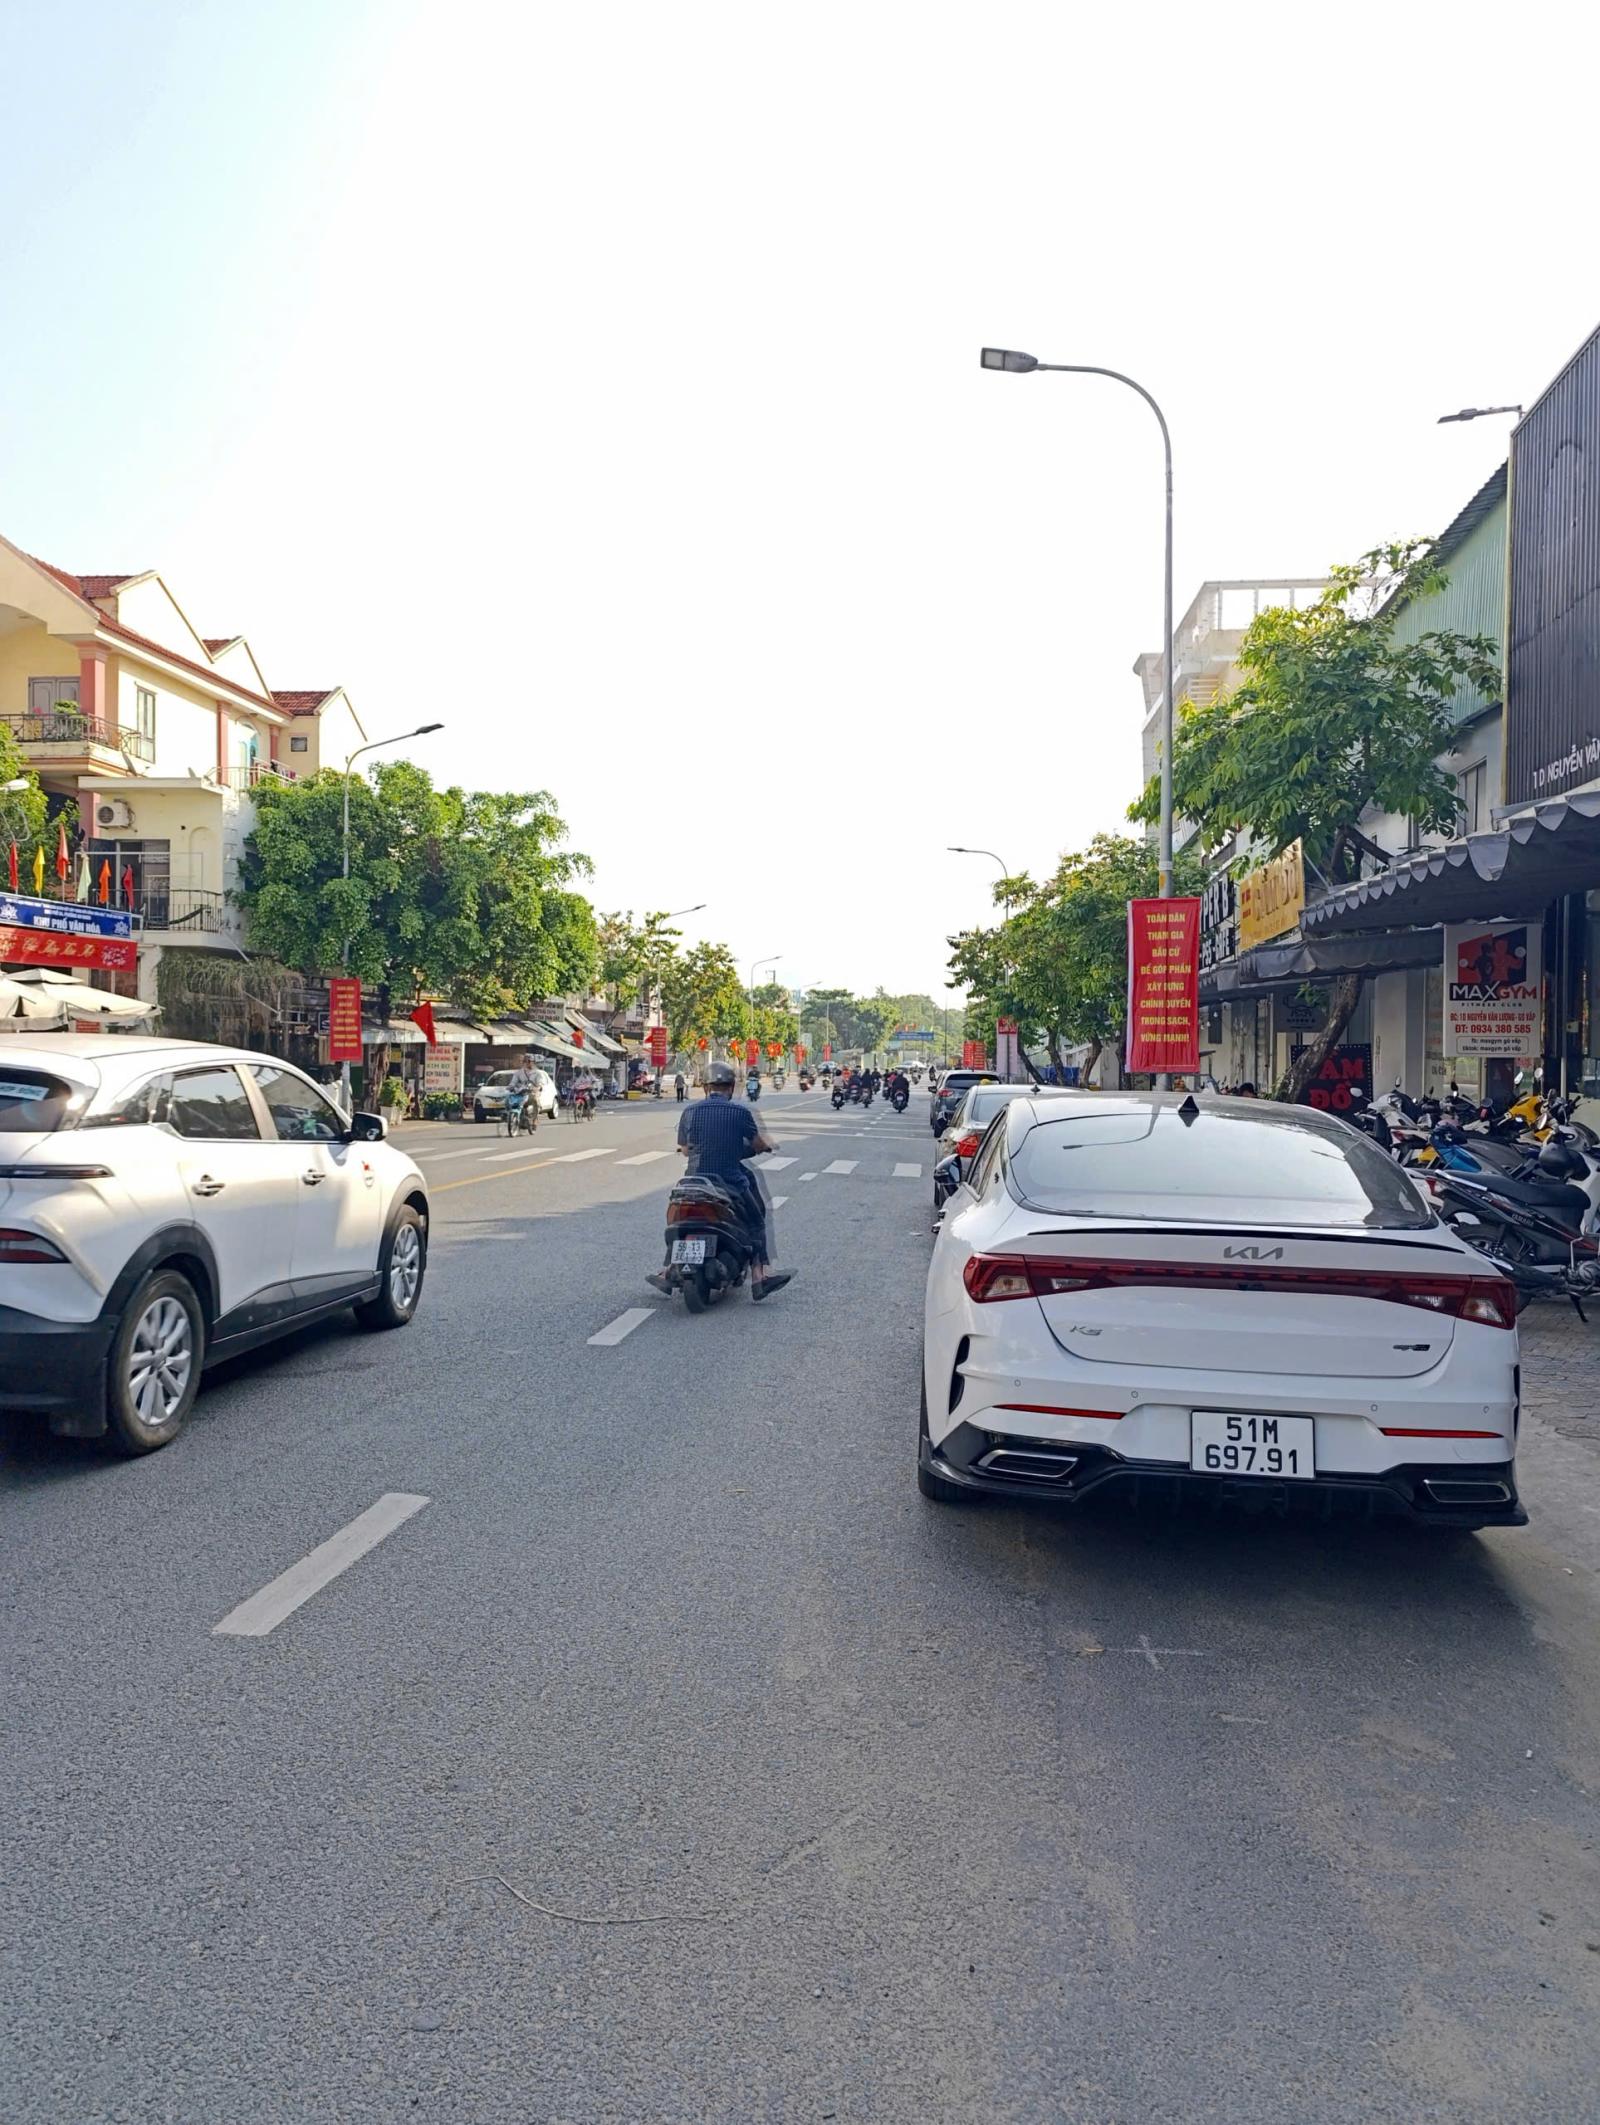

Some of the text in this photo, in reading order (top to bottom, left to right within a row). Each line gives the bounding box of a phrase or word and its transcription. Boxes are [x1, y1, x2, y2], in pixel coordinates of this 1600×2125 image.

[1548, 744, 1582, 783] NGUYỄN
[1146, 912, 1186, 923] TOÀN DÂN
[33, 916, 100, 934] KHU PHỐ VĂN HÓA
[1148, 931, 1184, 940] THAM GIA
[1152, 946, 1167, 957] BẦU
[1152, 964, 1167, 974] GÓP
[1169, 963, 1191, 974] PHẦN
[1147, 982, 1162, 991] XÂY
[1140, 998, 1164, 1008] CHÍNH
[1141, 1016, 1166, 1025] TRONG
[1455, 1024, 1531, 1033] ĐT: 0934 380 585
[1140, 1032, 1162, 1042] VỮNG
[1223, 1246, 1284, 1260] KIA
[1226, 1416, 1278, 1443] 51M
[1206, 1444, 1298, 1474] 697.91
